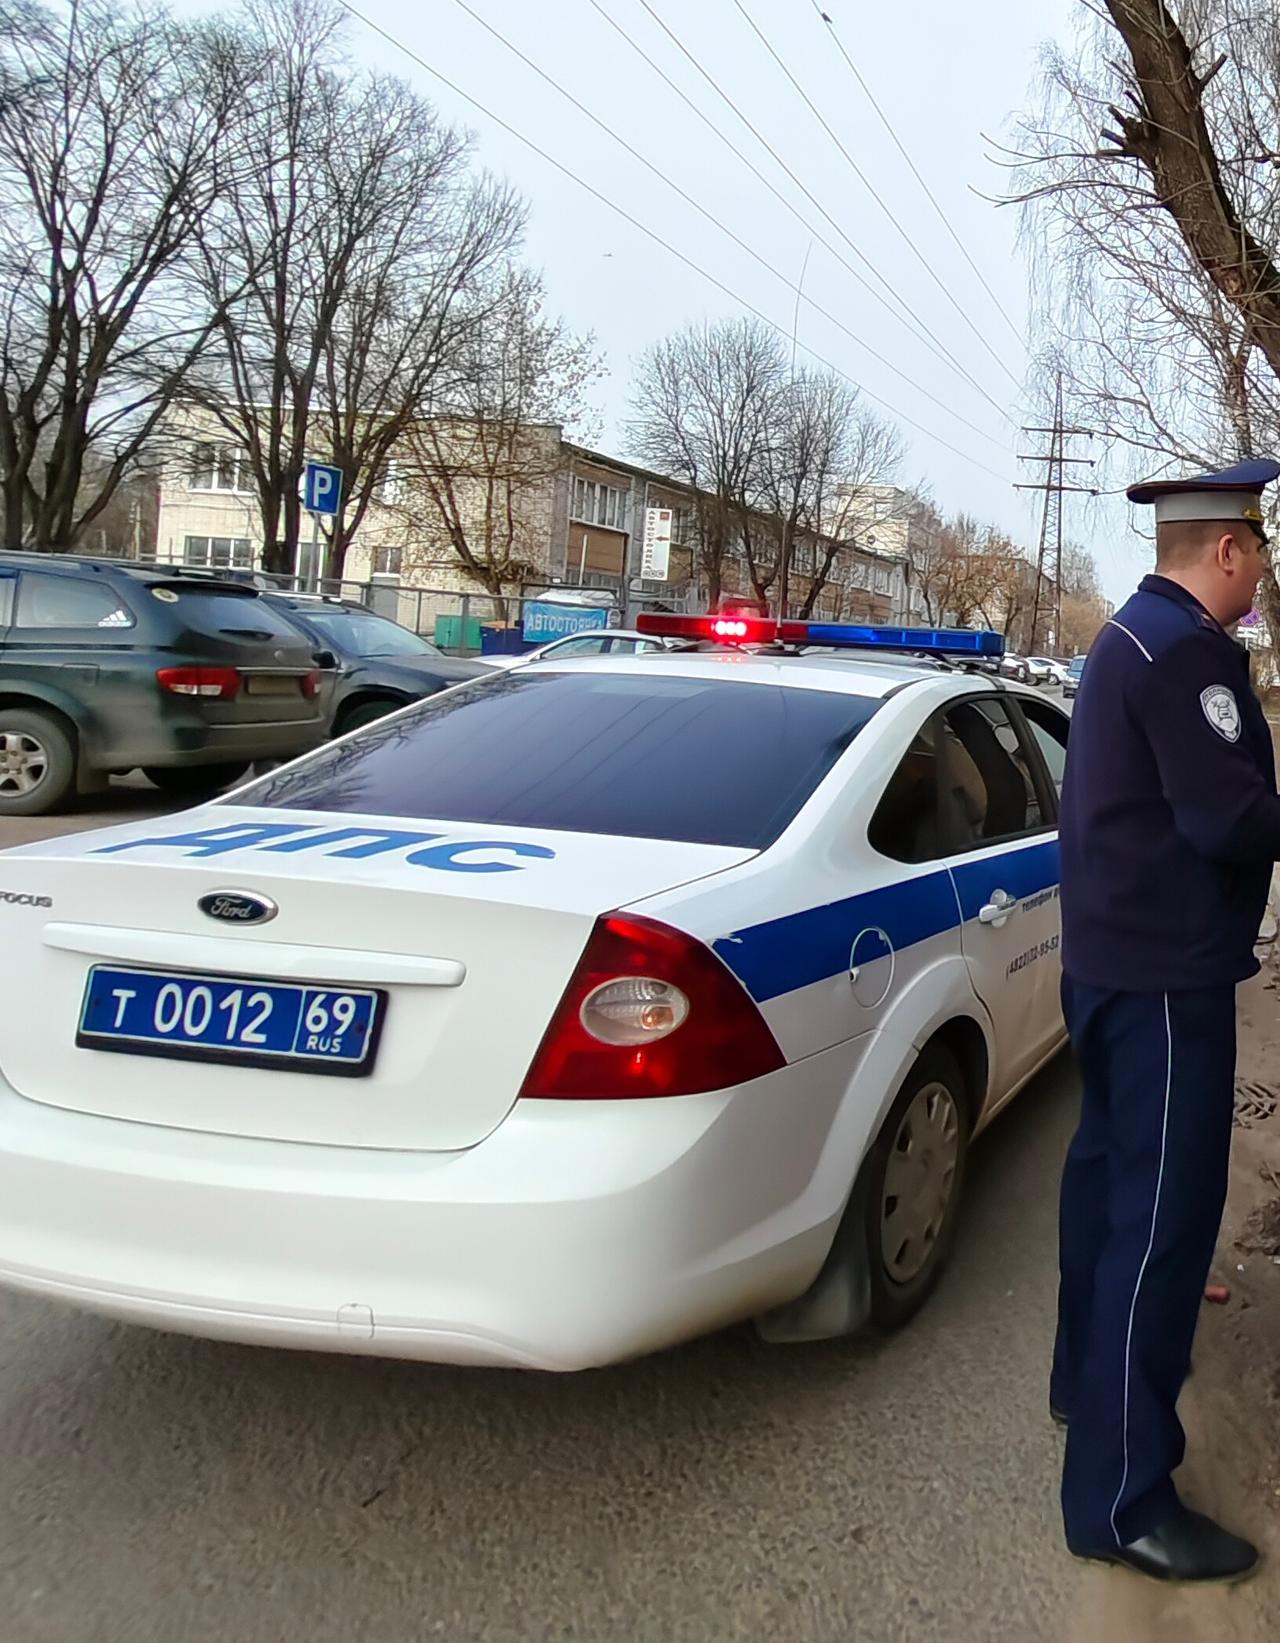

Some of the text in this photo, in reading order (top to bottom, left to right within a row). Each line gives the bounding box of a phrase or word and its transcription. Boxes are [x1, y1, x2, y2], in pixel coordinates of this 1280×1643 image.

[313, 470, 332, 507] P
[87, 822, 556, 873] ДПС
[210, 896, 256, 918] Ford
[112, 982, 357, 1044] Т 0012 69
[306, 1036, 342, 1054] RUS
